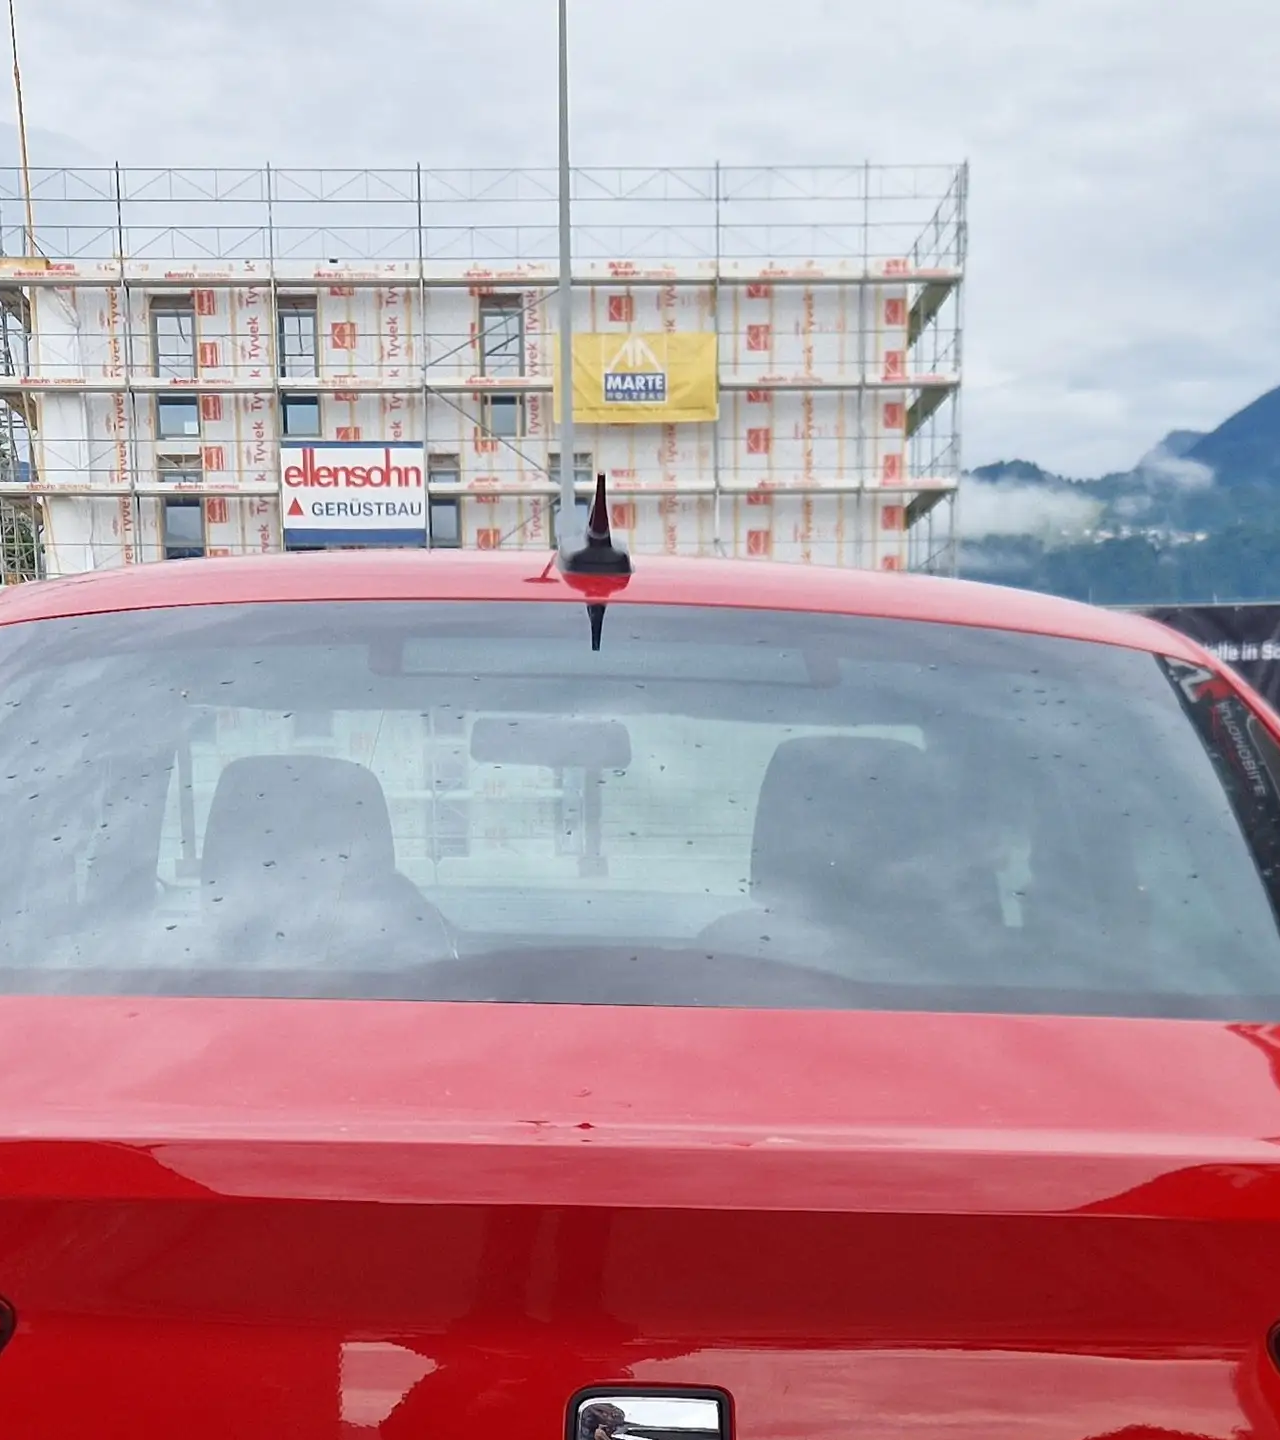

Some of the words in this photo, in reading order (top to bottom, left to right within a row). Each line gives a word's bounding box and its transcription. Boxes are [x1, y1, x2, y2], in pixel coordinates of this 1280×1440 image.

[247, 316, 261, 359] Tyvek
[386, 316, 400, 359] Tyvek
[526, 342, 538, 377] yvek
[607, 375, 663, 390] MARTE
[528, 395, 540, 435] Tyvek
[252, 421, 266, 463] Tyvek
[285, 448, 422, 487] ellensohn
[312, 499, 421, 516] GERÜSTBAU
[1241, 641, 1258, 661] in
